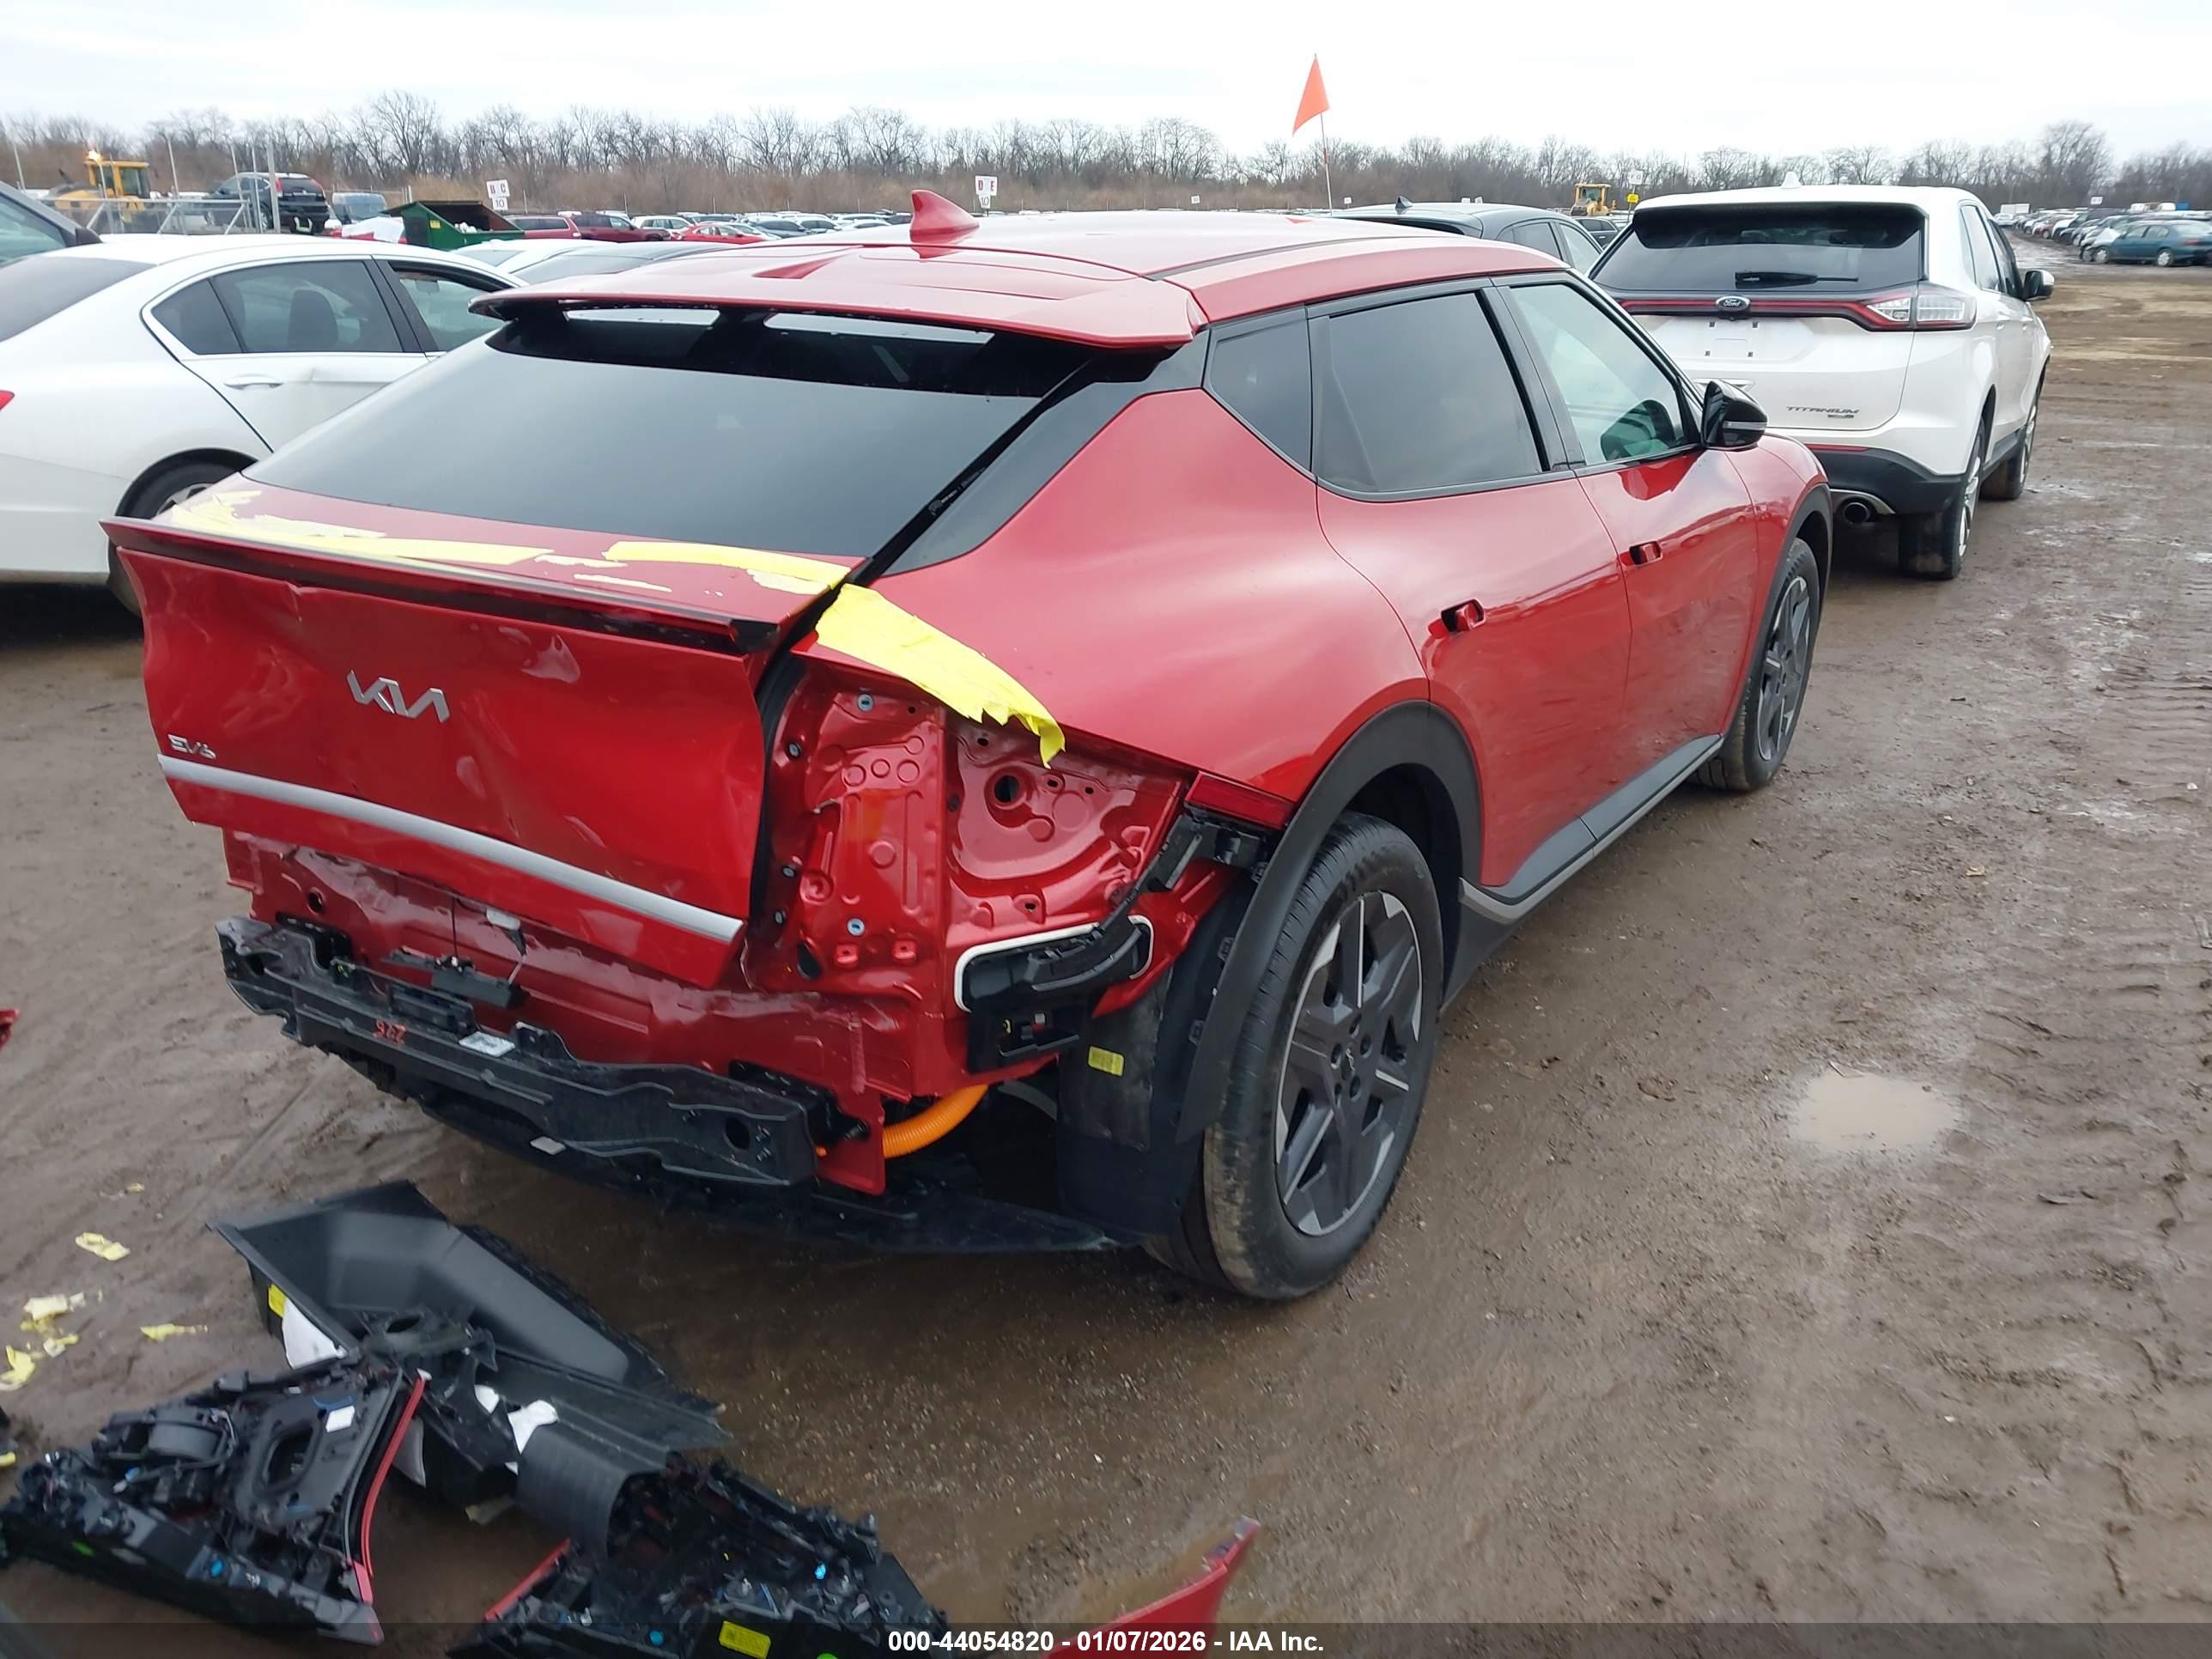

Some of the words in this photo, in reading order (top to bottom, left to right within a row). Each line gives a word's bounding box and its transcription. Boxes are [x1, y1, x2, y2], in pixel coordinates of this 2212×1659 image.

[500, 183, 506, 193] C
[495, 198, 505, 208] 10
[981, 196, 989, 206] 10
[1723, 299, 1741, 307] Ford
[1786, 406, 1859, 414] TITANIUM
[346, 669, 451, 723] KIA
[167, 732, 216, 760] EV6
